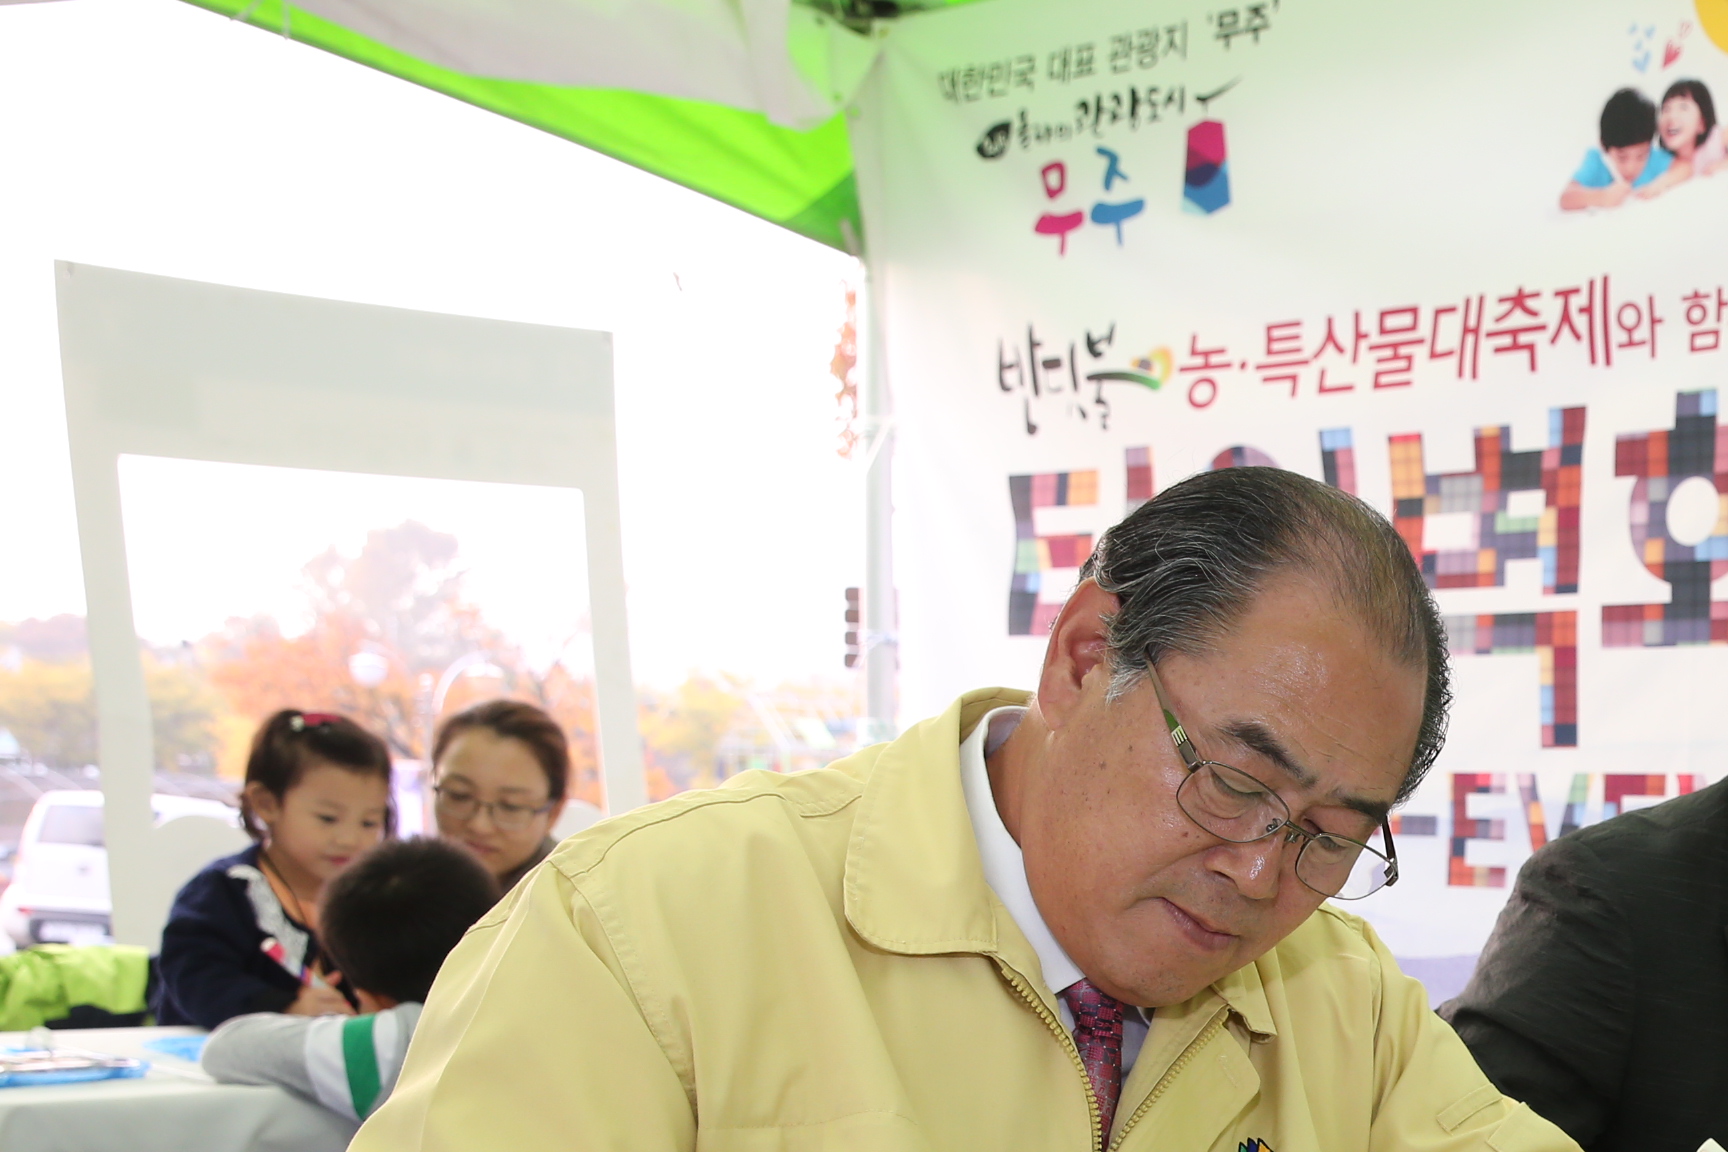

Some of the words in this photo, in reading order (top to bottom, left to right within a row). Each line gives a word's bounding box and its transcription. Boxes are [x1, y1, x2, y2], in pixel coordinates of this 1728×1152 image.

[938, 56, 1037, 103] 대한민국
[1047, 45, 1096, 84] 대표
[1108, 21, 1188, 76] 관광지
[1032, 144, 1147, 258] 무주
